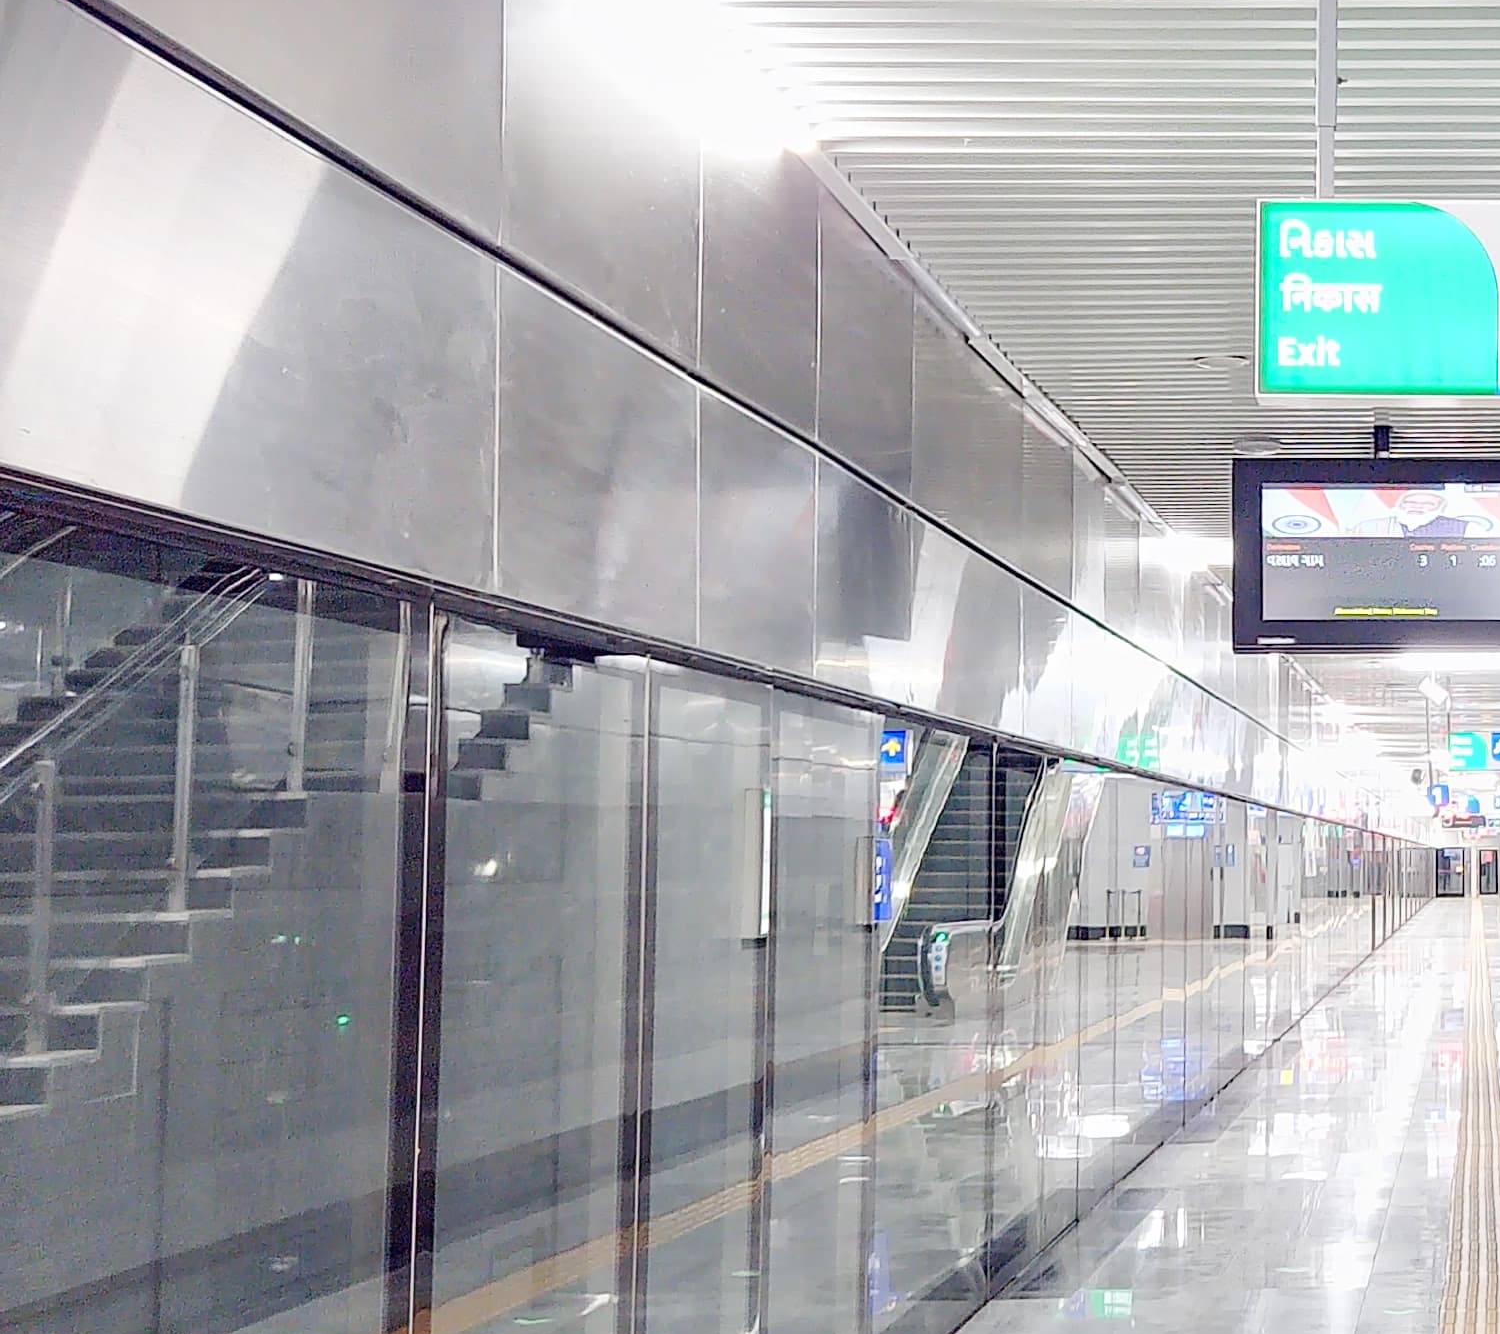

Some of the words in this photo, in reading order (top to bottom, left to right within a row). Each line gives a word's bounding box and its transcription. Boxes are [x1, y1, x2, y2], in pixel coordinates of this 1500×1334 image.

[1279, 219, 1377, 259] નિકાસ
[1279, 272, 1384, 313] निकास
[1277, 335, 1342, 367] Exit
